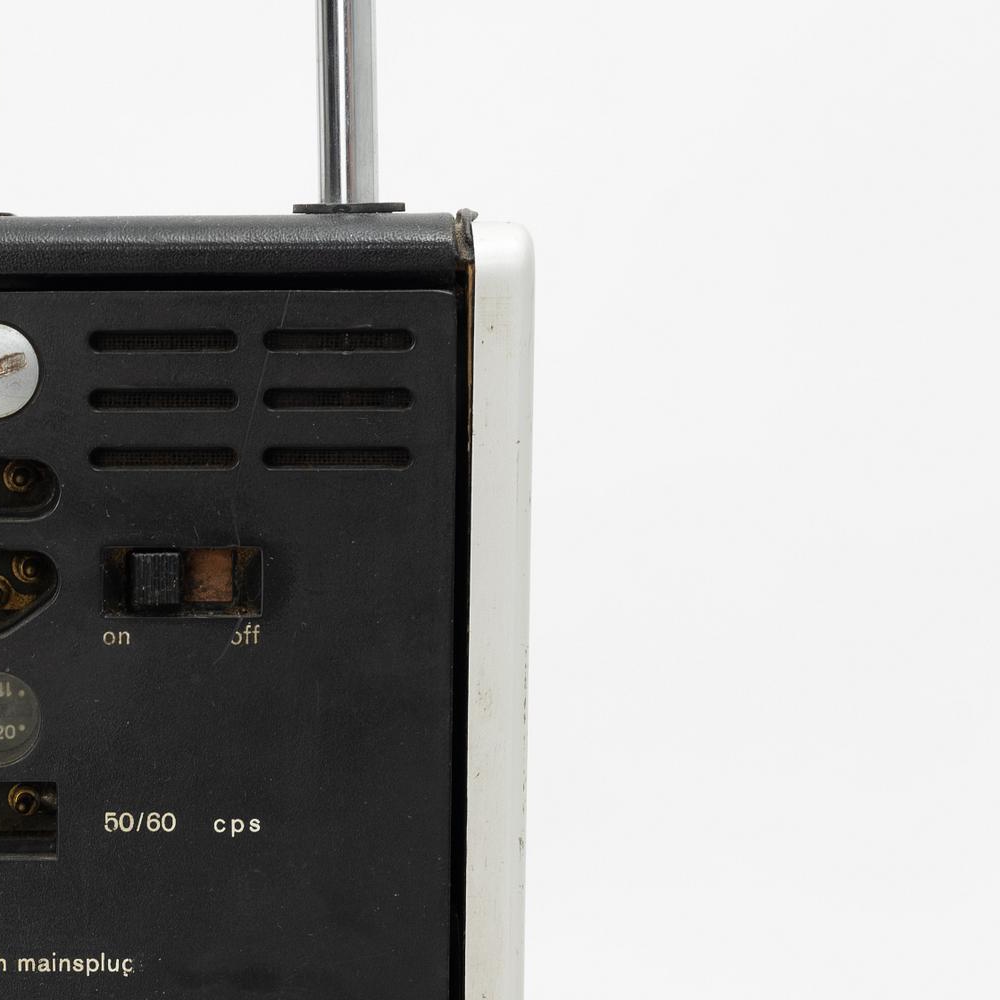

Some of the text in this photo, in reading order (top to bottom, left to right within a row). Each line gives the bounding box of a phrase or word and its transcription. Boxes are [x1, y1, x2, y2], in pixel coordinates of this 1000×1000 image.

[102, 630, 130, 646] on
[230, 622, 261, 646] off
[103, 811, 261, 838] 50/60 cps
